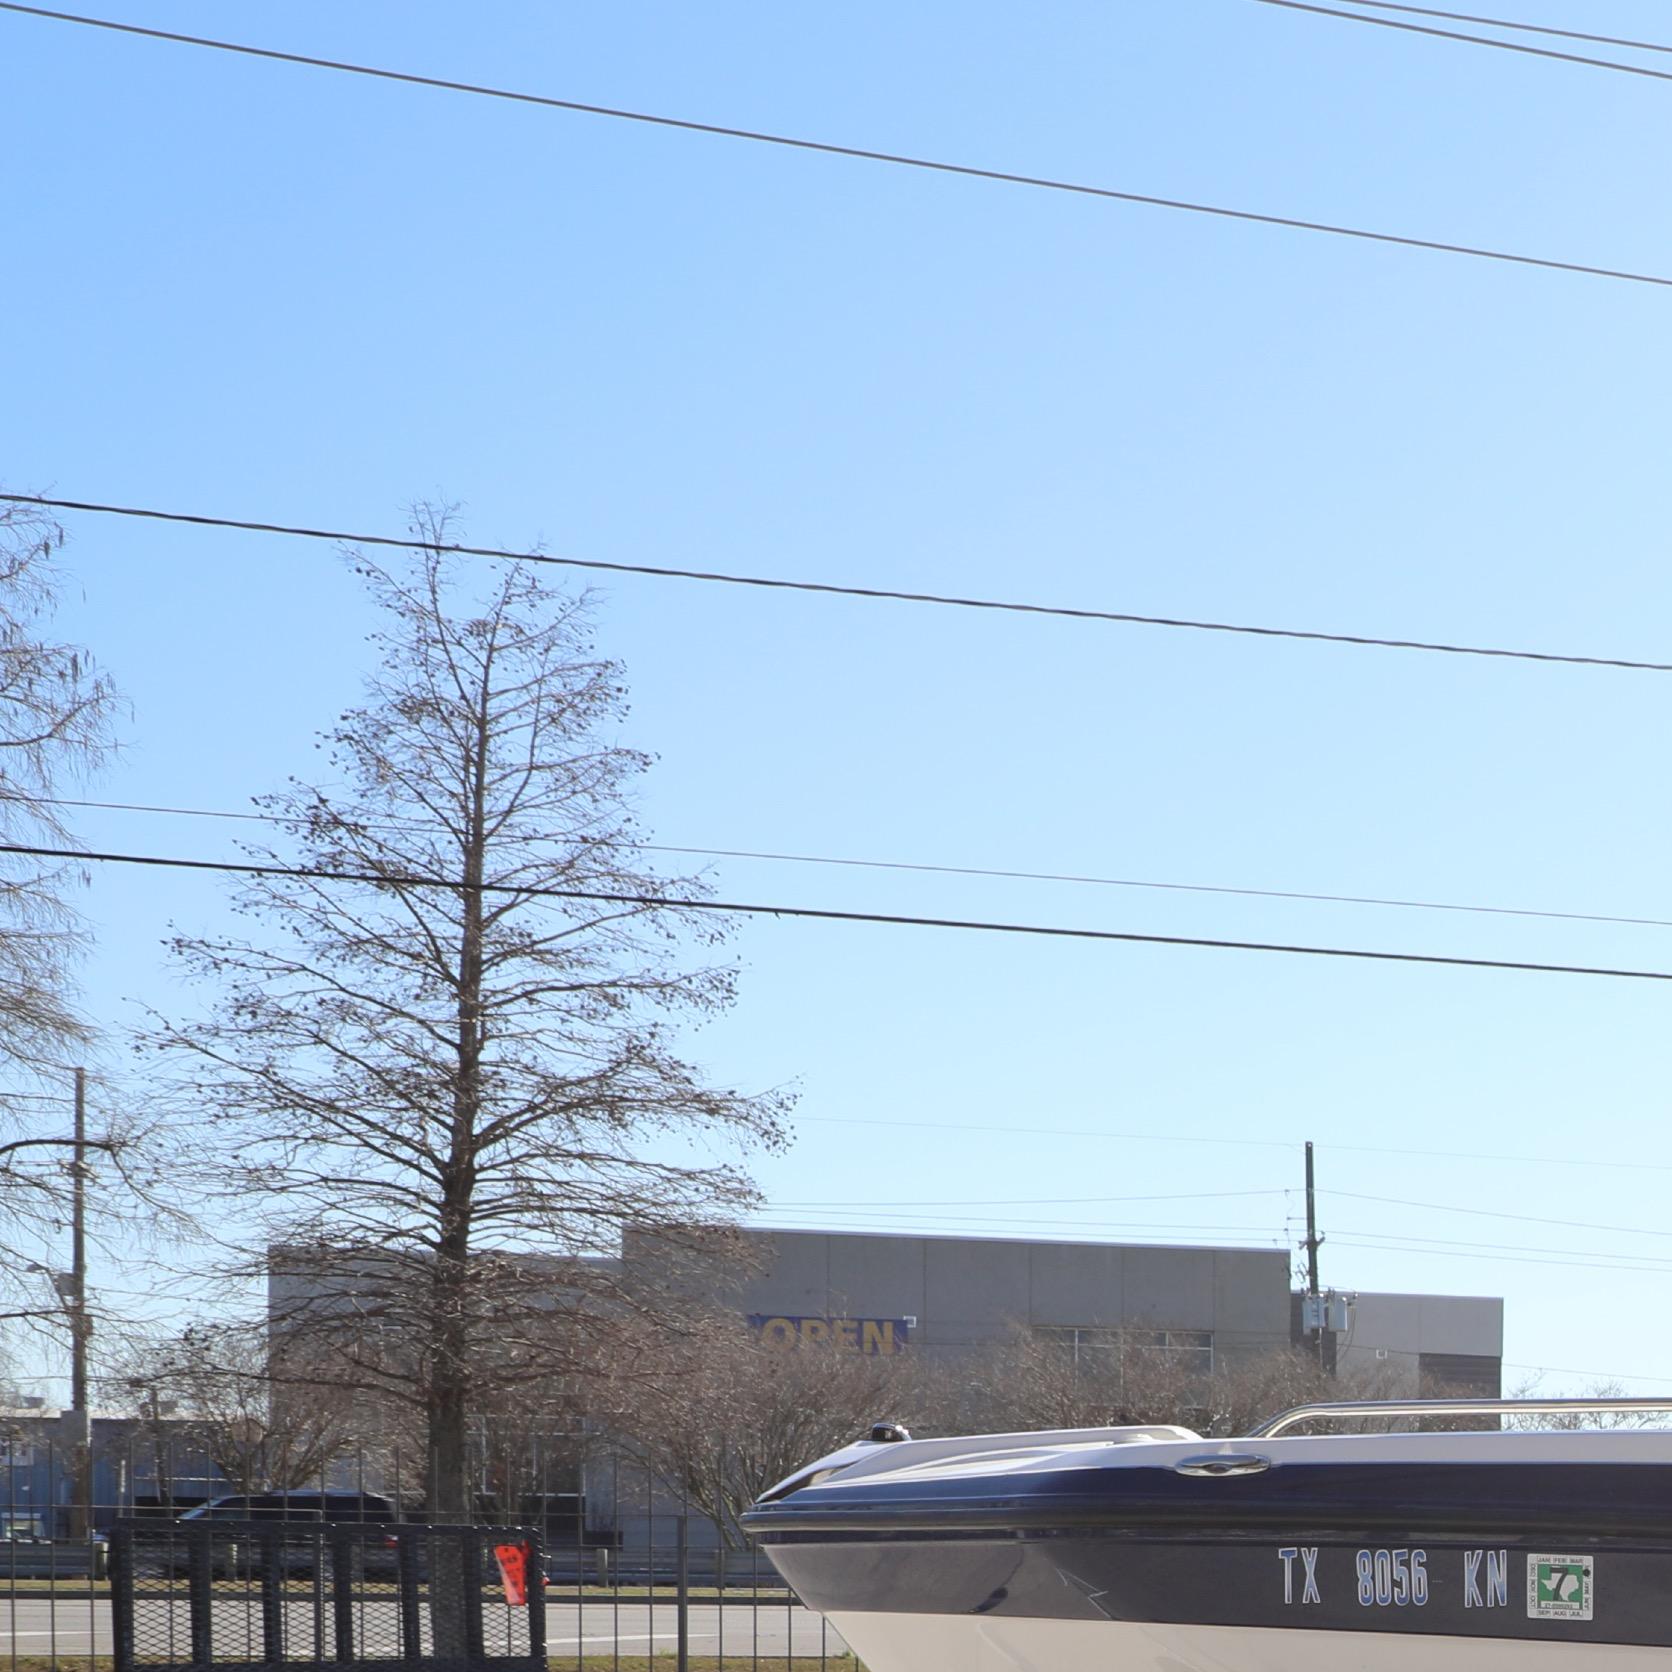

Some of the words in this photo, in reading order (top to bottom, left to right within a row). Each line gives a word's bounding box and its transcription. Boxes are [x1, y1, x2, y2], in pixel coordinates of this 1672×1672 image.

[762, 1317, 894, 1355] OPEN
[1278, 1547, 1321, 1604] TX
[1356, 1549, 1429, 1607] 8056
[1464, 1549, 1508, 1608] KN
